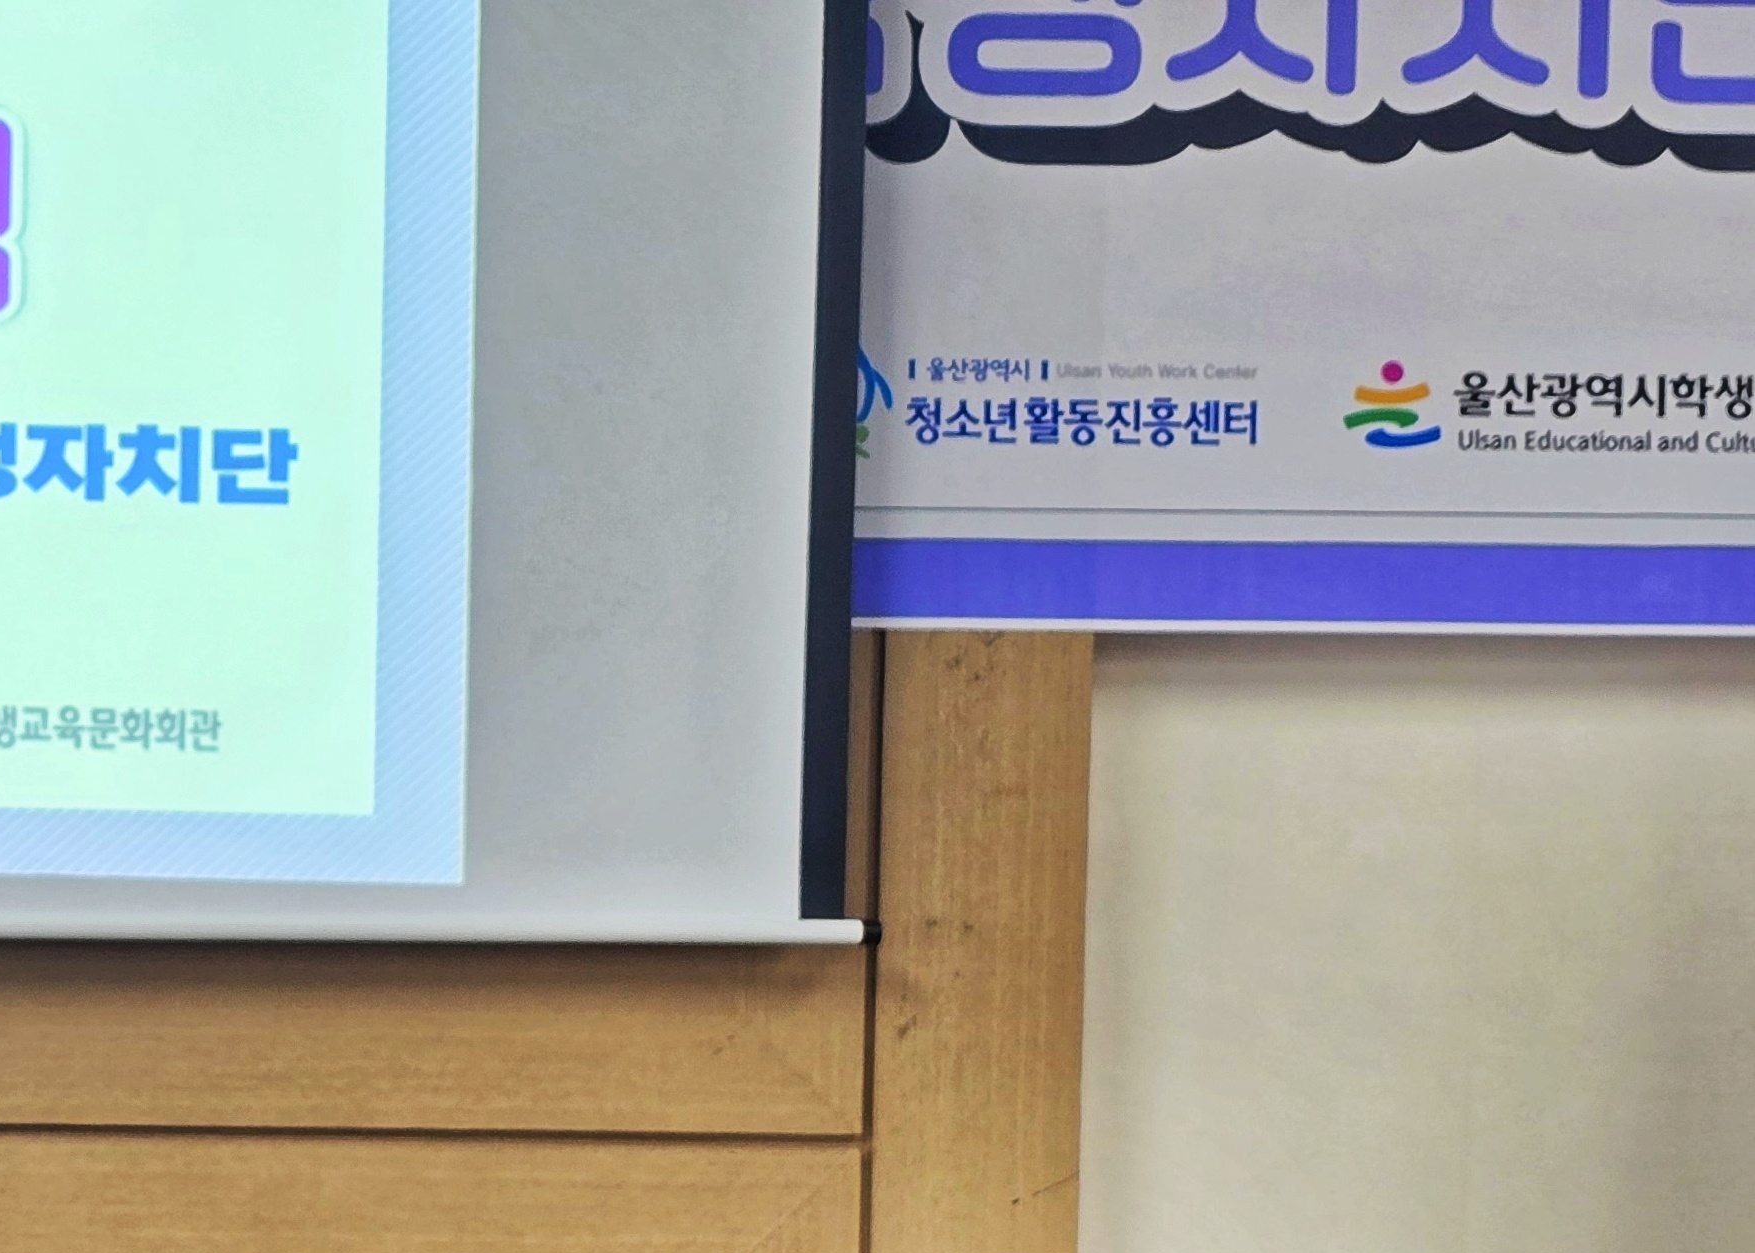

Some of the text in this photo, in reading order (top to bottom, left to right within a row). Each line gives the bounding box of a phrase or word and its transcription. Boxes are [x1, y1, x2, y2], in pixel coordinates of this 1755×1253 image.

[926, 356, 1030, 383] 울산광역시
[1107, 362, 1153, 380] Youth
[1157, 362, 1197, 380] Work
[1202, 362, 1259, 381] Center
[1458, 428, 1517, 451] Ulsan
[1524, 428, 1652, 452] Educational
[1657, 429, 1699, 451] and
